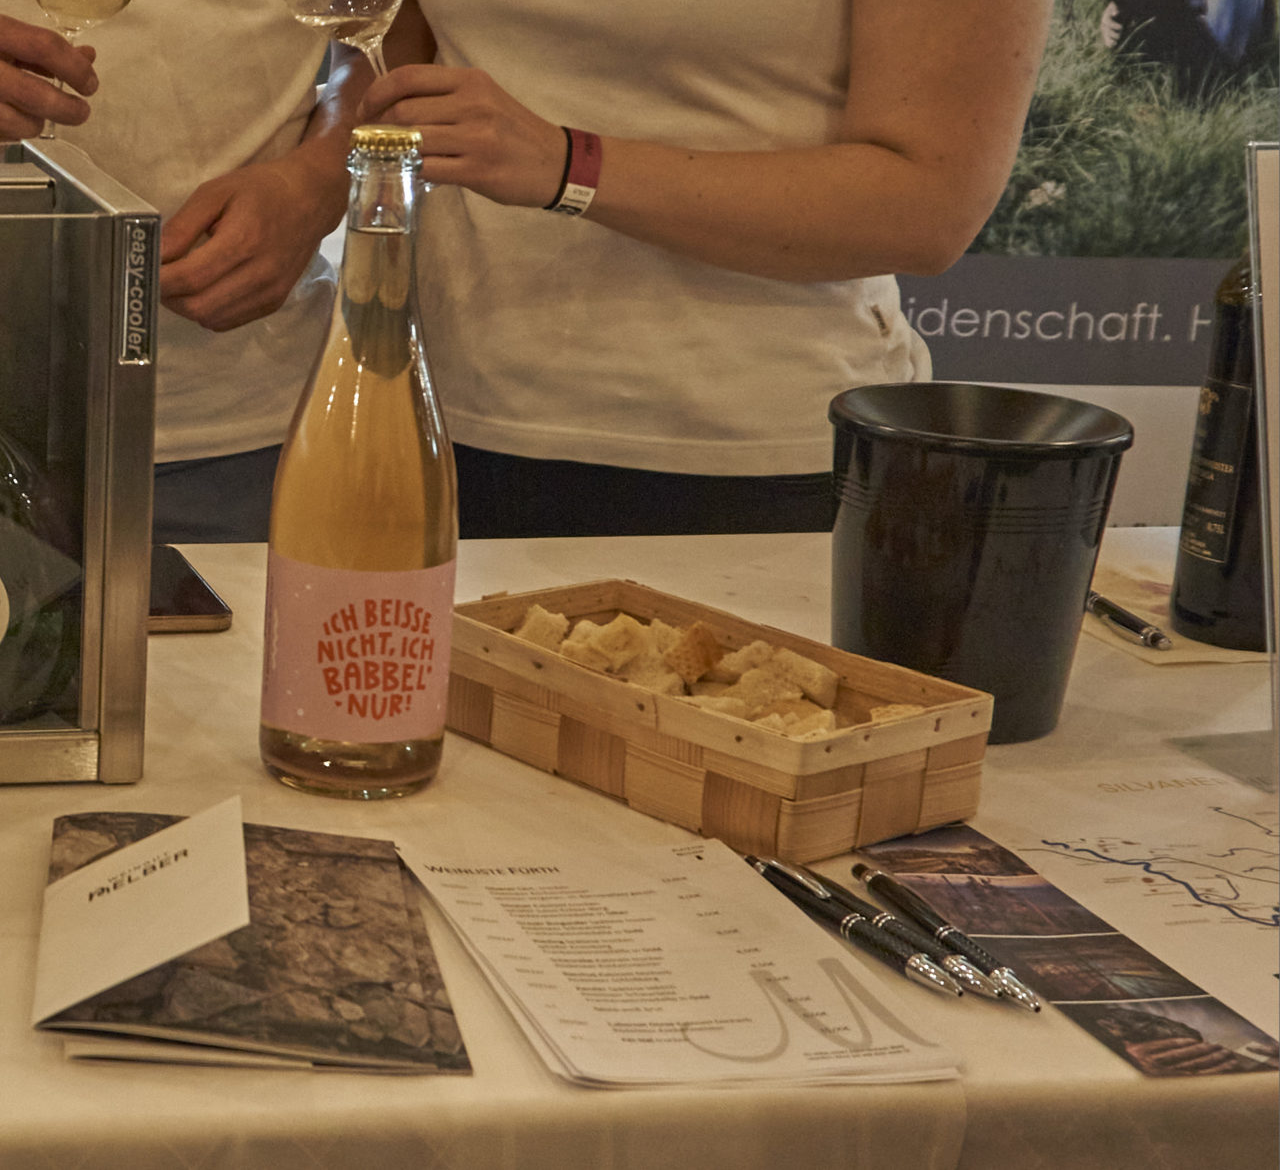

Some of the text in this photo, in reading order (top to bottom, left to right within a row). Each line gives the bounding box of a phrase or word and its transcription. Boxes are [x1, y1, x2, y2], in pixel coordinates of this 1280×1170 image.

[128, 227, 146, 355] easy-cooler
[906, 297, 1172, 343] idenschaft.
[323, 598, 432, 636] ICH BEISSE
[317, 632, 435, 663] NICHT, ICH
[347, 693, 412, 720] NUR!
[1097, 776, 1228, 794] SILVANE
